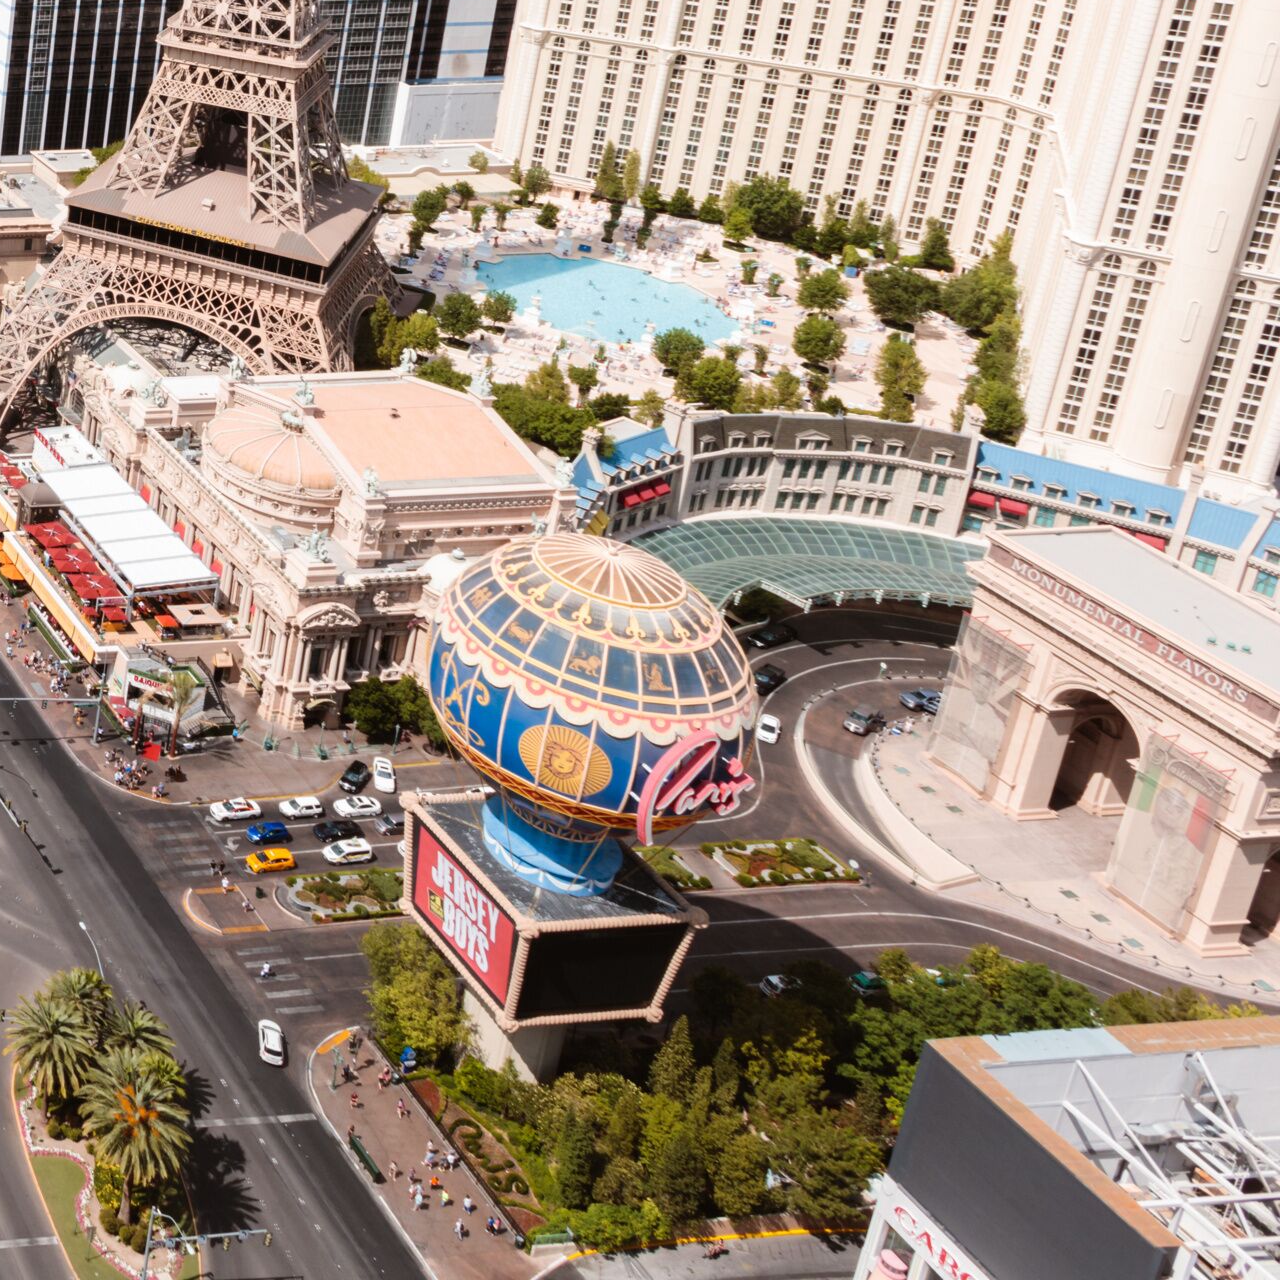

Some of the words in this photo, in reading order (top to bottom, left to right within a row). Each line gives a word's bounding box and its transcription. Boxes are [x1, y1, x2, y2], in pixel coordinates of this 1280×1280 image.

[1011, 558, 1144, 645] MONUMENTAL
[1156, 642, 1249, 704] FLAVORS
[637, 729, 756, 846] Paris
[432, 851, 499, 944] JERSEY
[442, 896, 489, 973] BOYS
